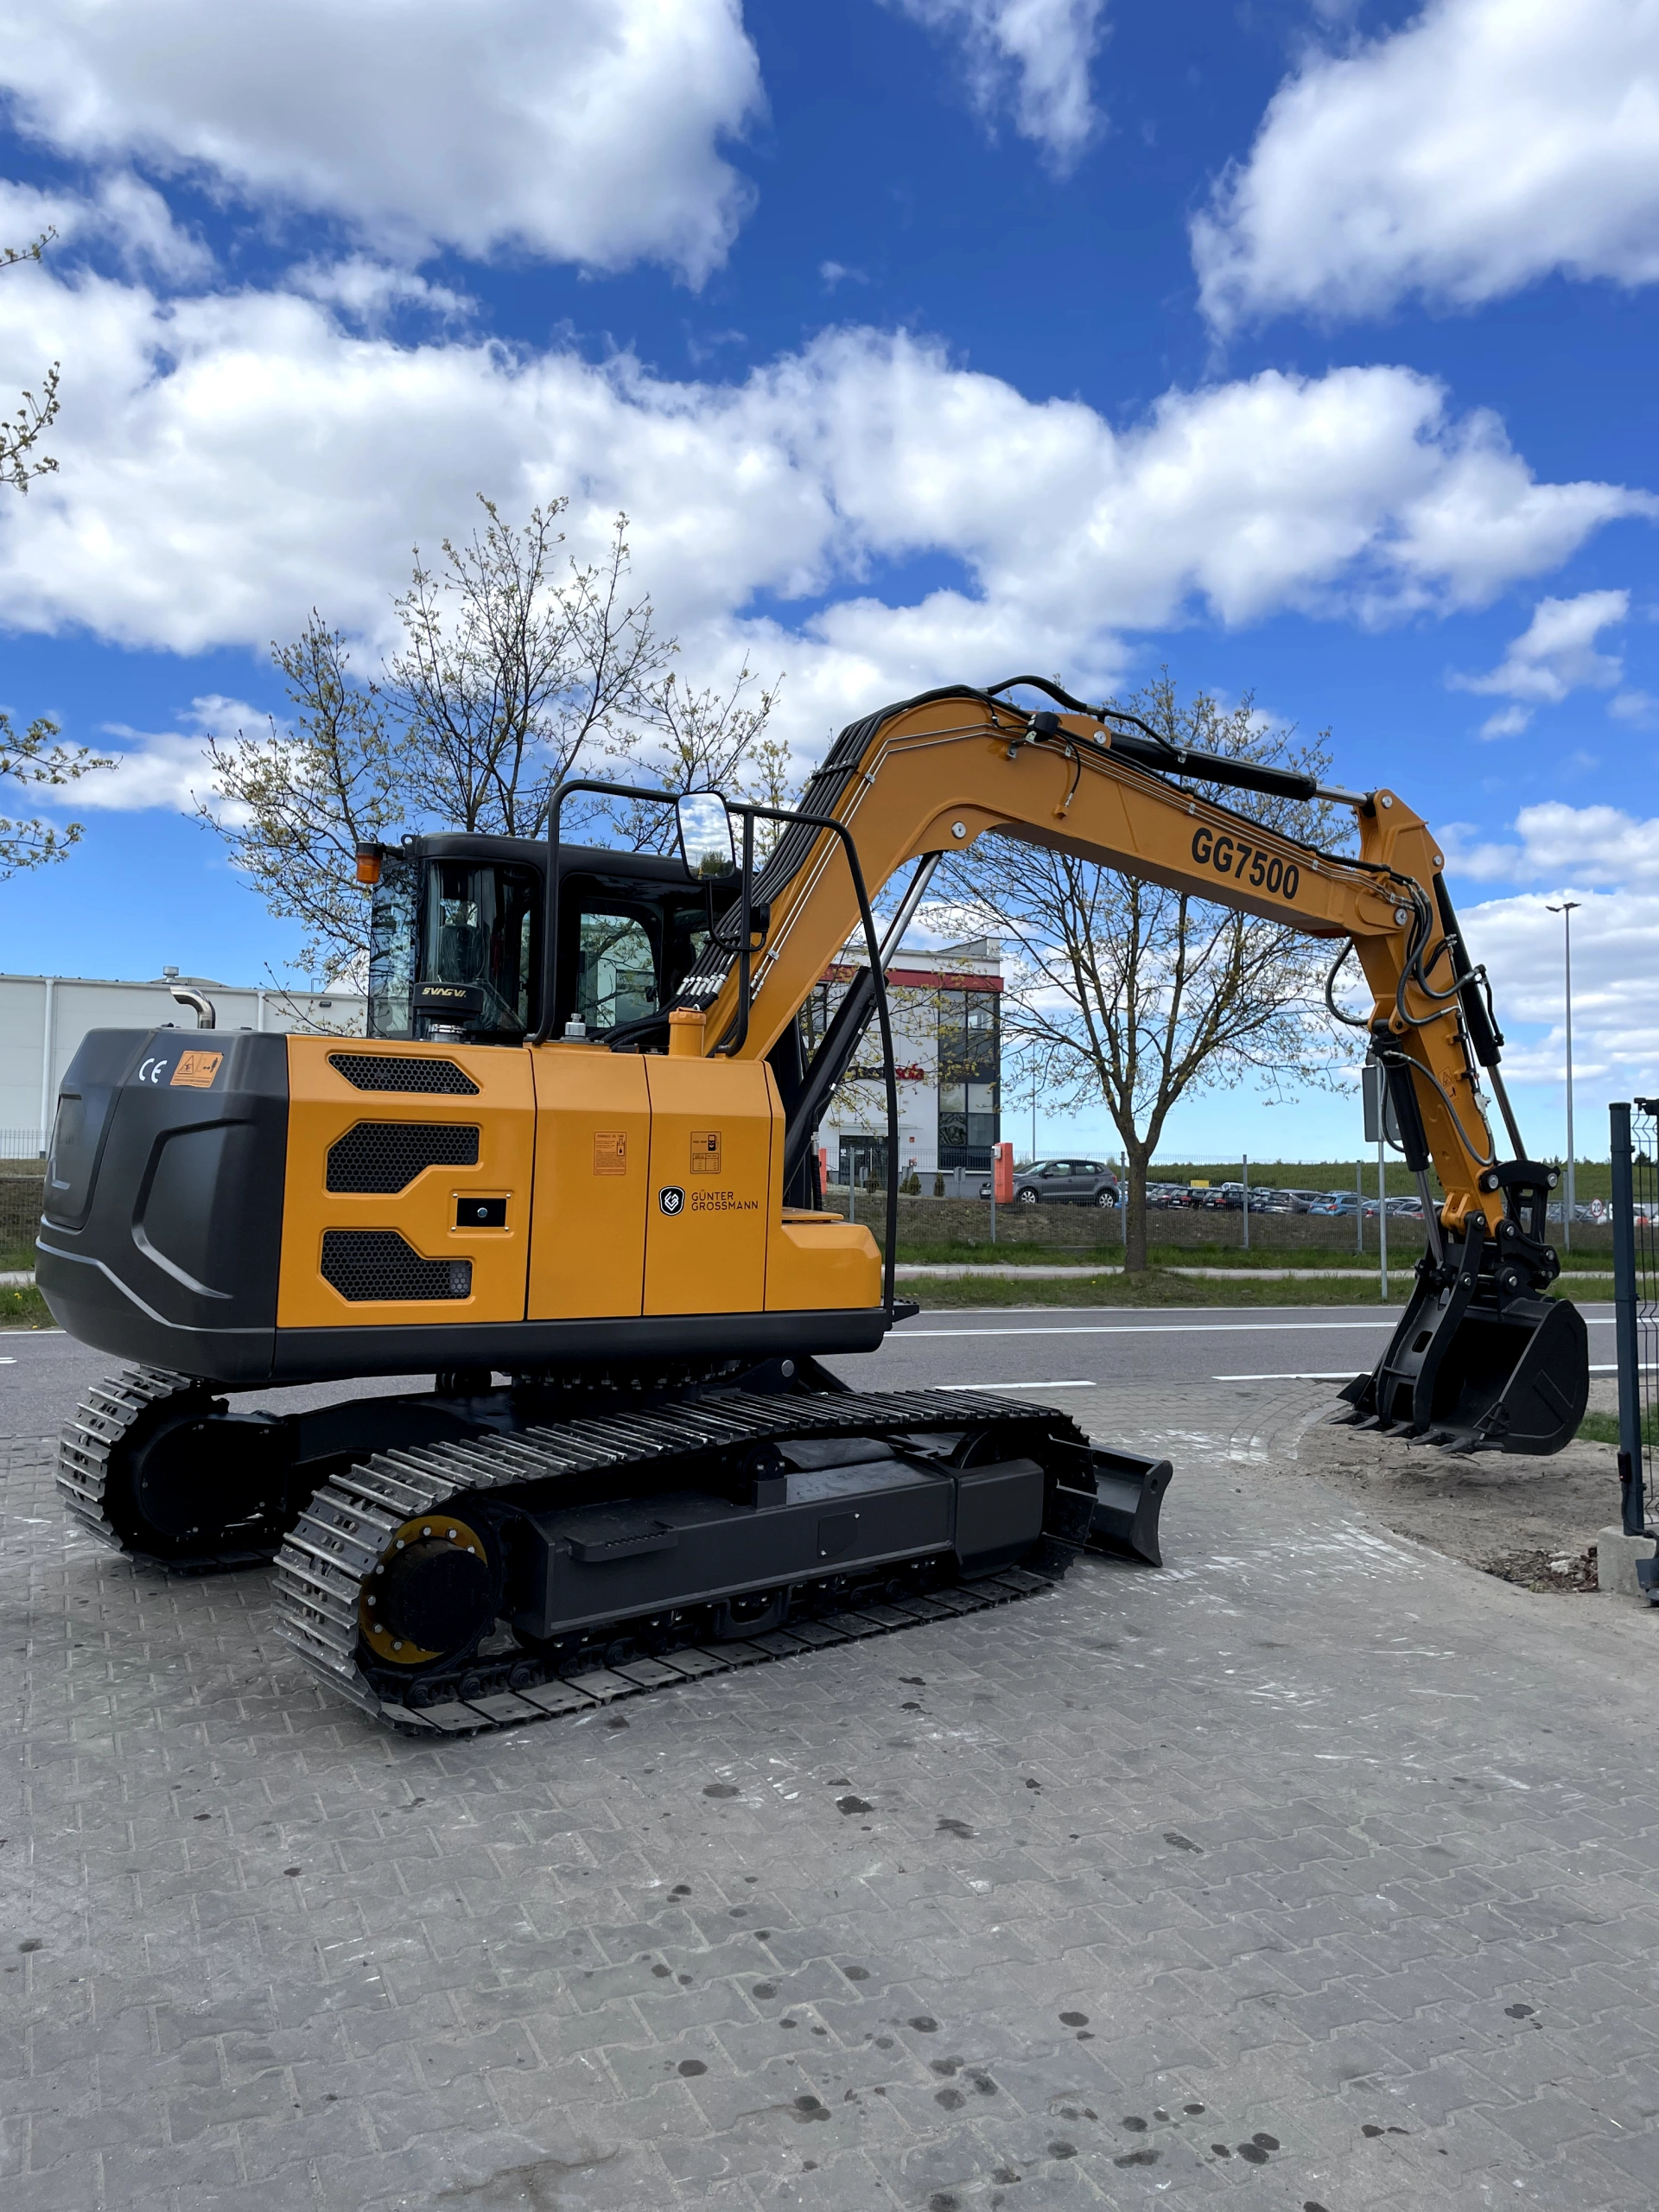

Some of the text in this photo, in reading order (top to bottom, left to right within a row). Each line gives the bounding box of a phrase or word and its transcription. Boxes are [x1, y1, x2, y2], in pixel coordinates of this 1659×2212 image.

[1192, 827, 1299, 899] GG7500
[139, 1058, 168, 1084] CE
[691, 1189, 734, 1202] GÜNTER
[691, 1200, 759, 1211] GROSSMANN
[1593, 1203, 1601, 1212] 20
